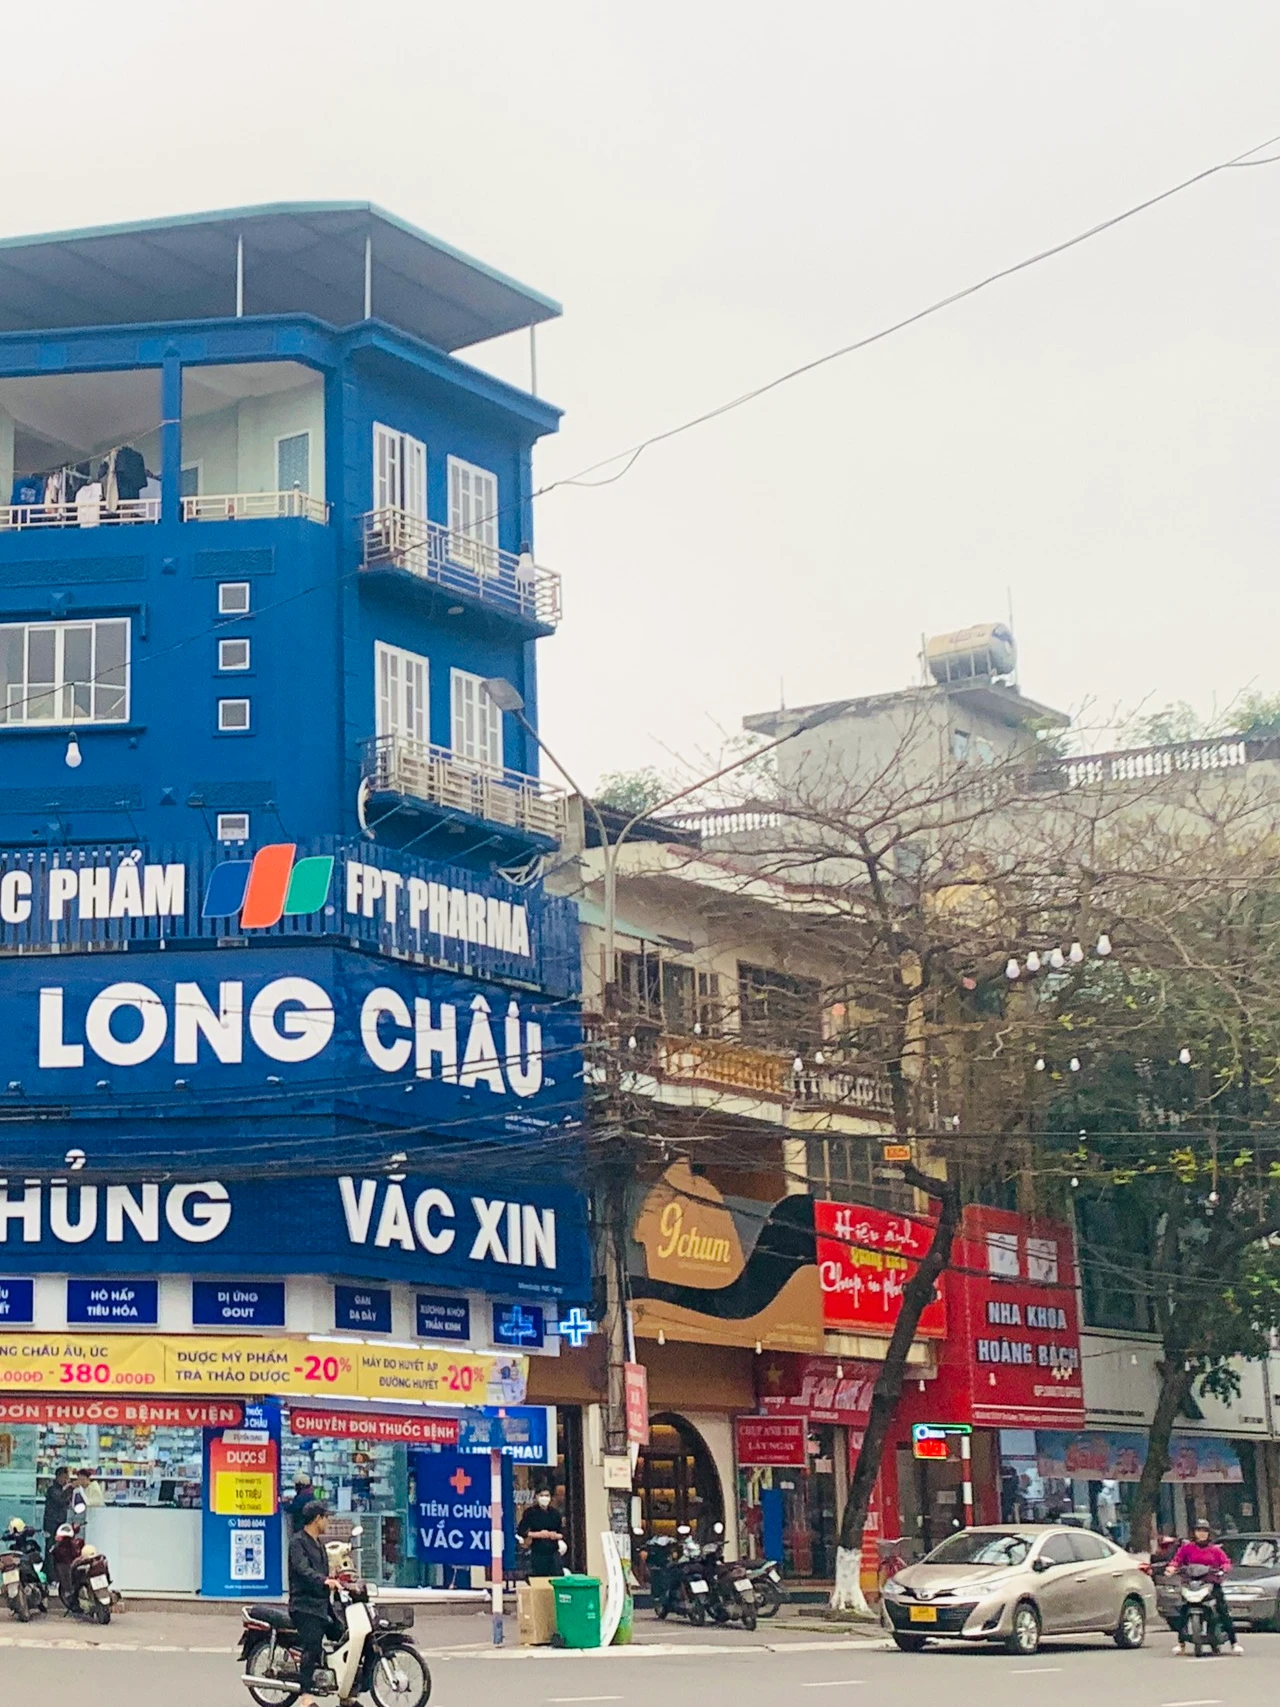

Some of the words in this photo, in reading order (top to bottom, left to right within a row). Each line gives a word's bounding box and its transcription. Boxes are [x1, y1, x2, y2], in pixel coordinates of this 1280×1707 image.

[48, 848, 185, 921] PHẨM
[346, 861, 402, 924] FPT
[407, 876, 531, 958] PHARMA
[39, 976, 335, 1069] LONG
[359, 986, 544, 1098] CHÂU
[338, 1152, 456, 1255] VẮC
[469, 1197, 556, 1269] XIN
[90, 1288, 109, 1301] HÔ
[111, 1287, 135, 1302] HẤP
[217, 1291, 230, 1305] DỊ
[232, 1289, 259, 1303] ỨNG
[86, 1303, 110, 1317] TIÊU
[222, 1307, 255, 1318] GOUT
[987, 1302, 1021, 1326] NHA
[1026, 1305, 1068, 1330] KHOA
[22, 1343, 60, 1357] CHÂU
[90, 1344, 108, 1357] ÚC
[177, 1350, 217, 1365] DƯỢC
[222, 1350, 243, 1363] MỸ
[247, 1349, 288, 1364] PHẨM
[977, 1337, 1033, 1364] HOÀNG
[294, 1354, 352, 1383] -20%
[362, 1355, 381, 1369] MÁY
[207, 1366, 245, 1382] THẢO
[249, 1370, 290, 1384] DƯỢC
[46, 1401, 119, 1419] THUỐC
[125, 1405, 180, 1421] BỆNH
[186, 1405, 234, 1424] VIỆN
[295, 1414, 347, 1432] CHUYÊN
[349, 1418, 376, 1434] ĐƠN
[379, 1418, 421, 1437] THUỐC
[423, 1423, 455, 1440] BỆNH
[226, 1449, 257, 1467] DƯỢC
[420, 1499, 450, 1518] TIÊM
[452, 1499, 504, 1519] CHỦN
[420, 1519, 464, 1550] VẮC
[469, 1529, 505, 1551] XI
